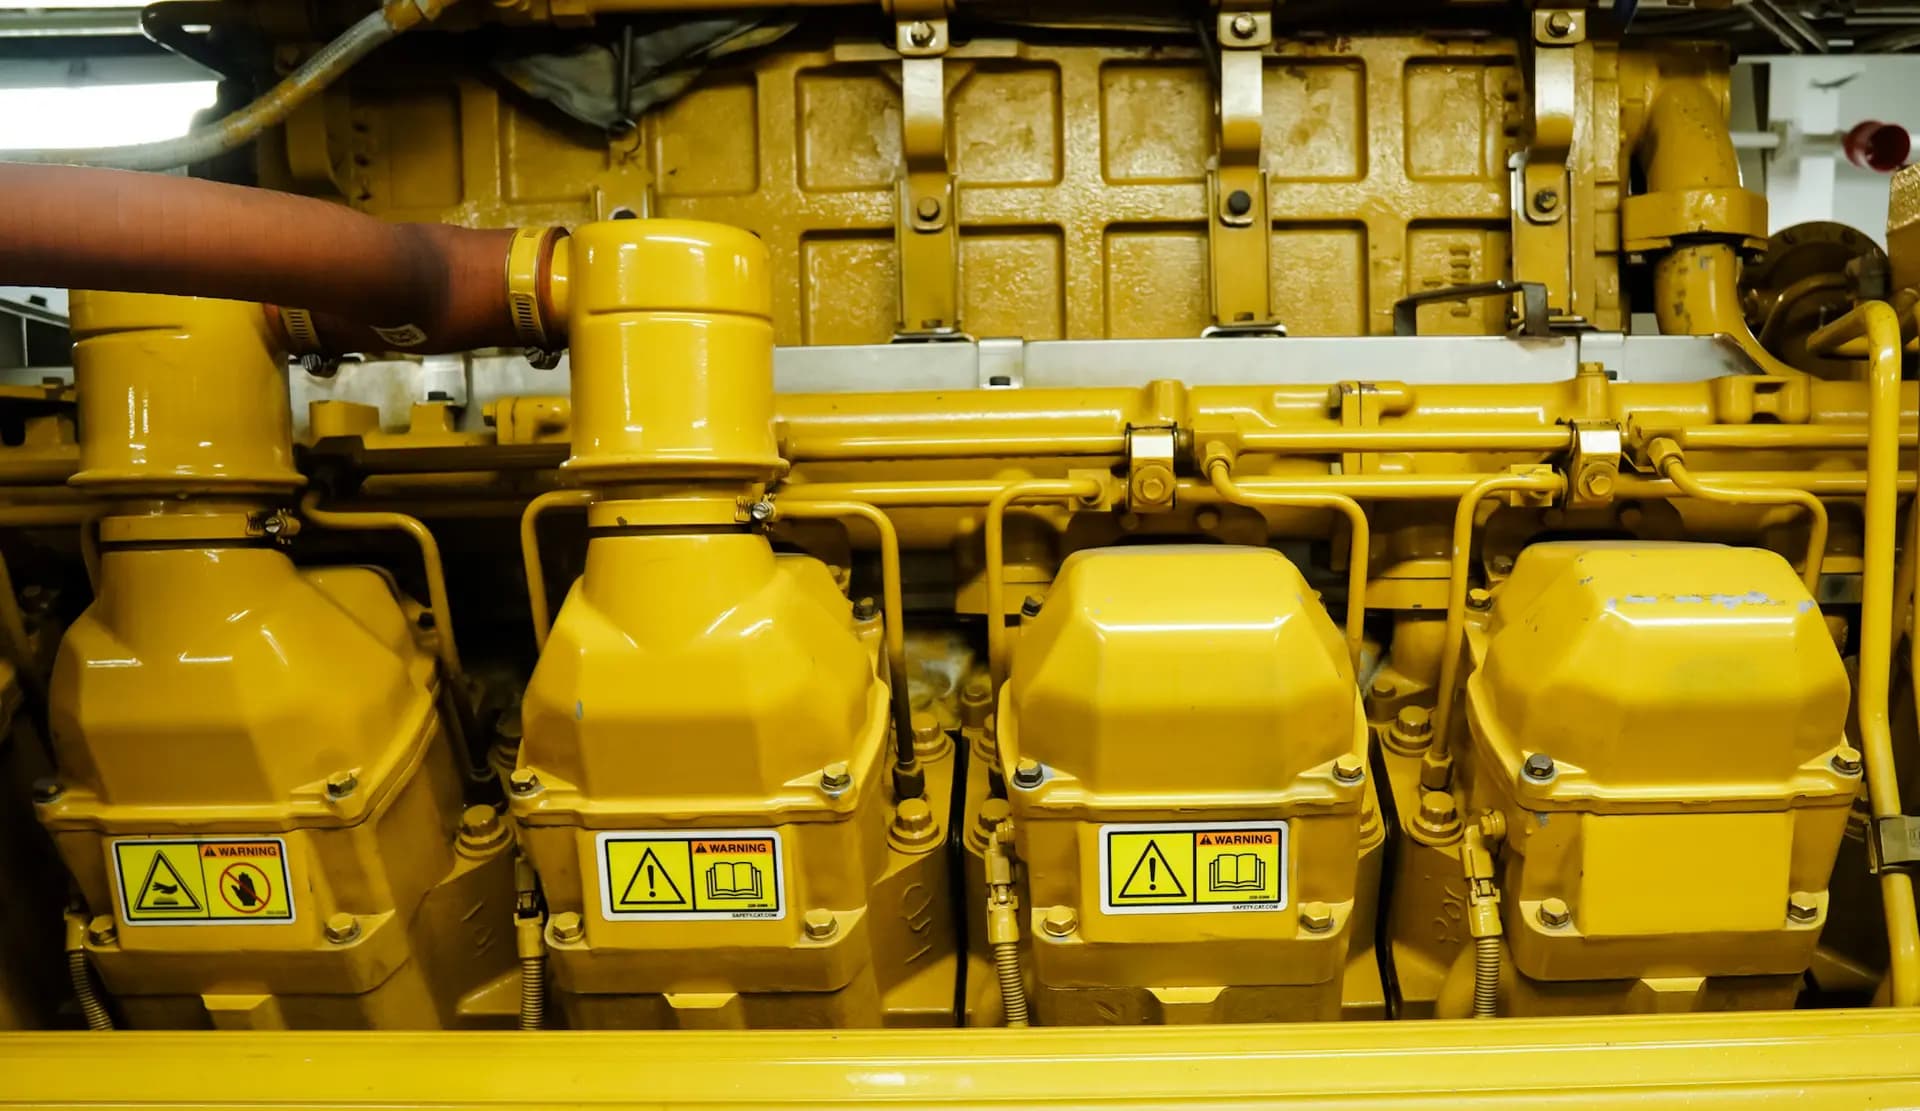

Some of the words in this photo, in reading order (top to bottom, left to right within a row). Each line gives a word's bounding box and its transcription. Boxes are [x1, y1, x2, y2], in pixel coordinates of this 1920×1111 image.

[1214, 834, 1273, 845] WARNING
[218, 846, 277, 857] WARNING
[709, 843, 767, 853] WARNING
